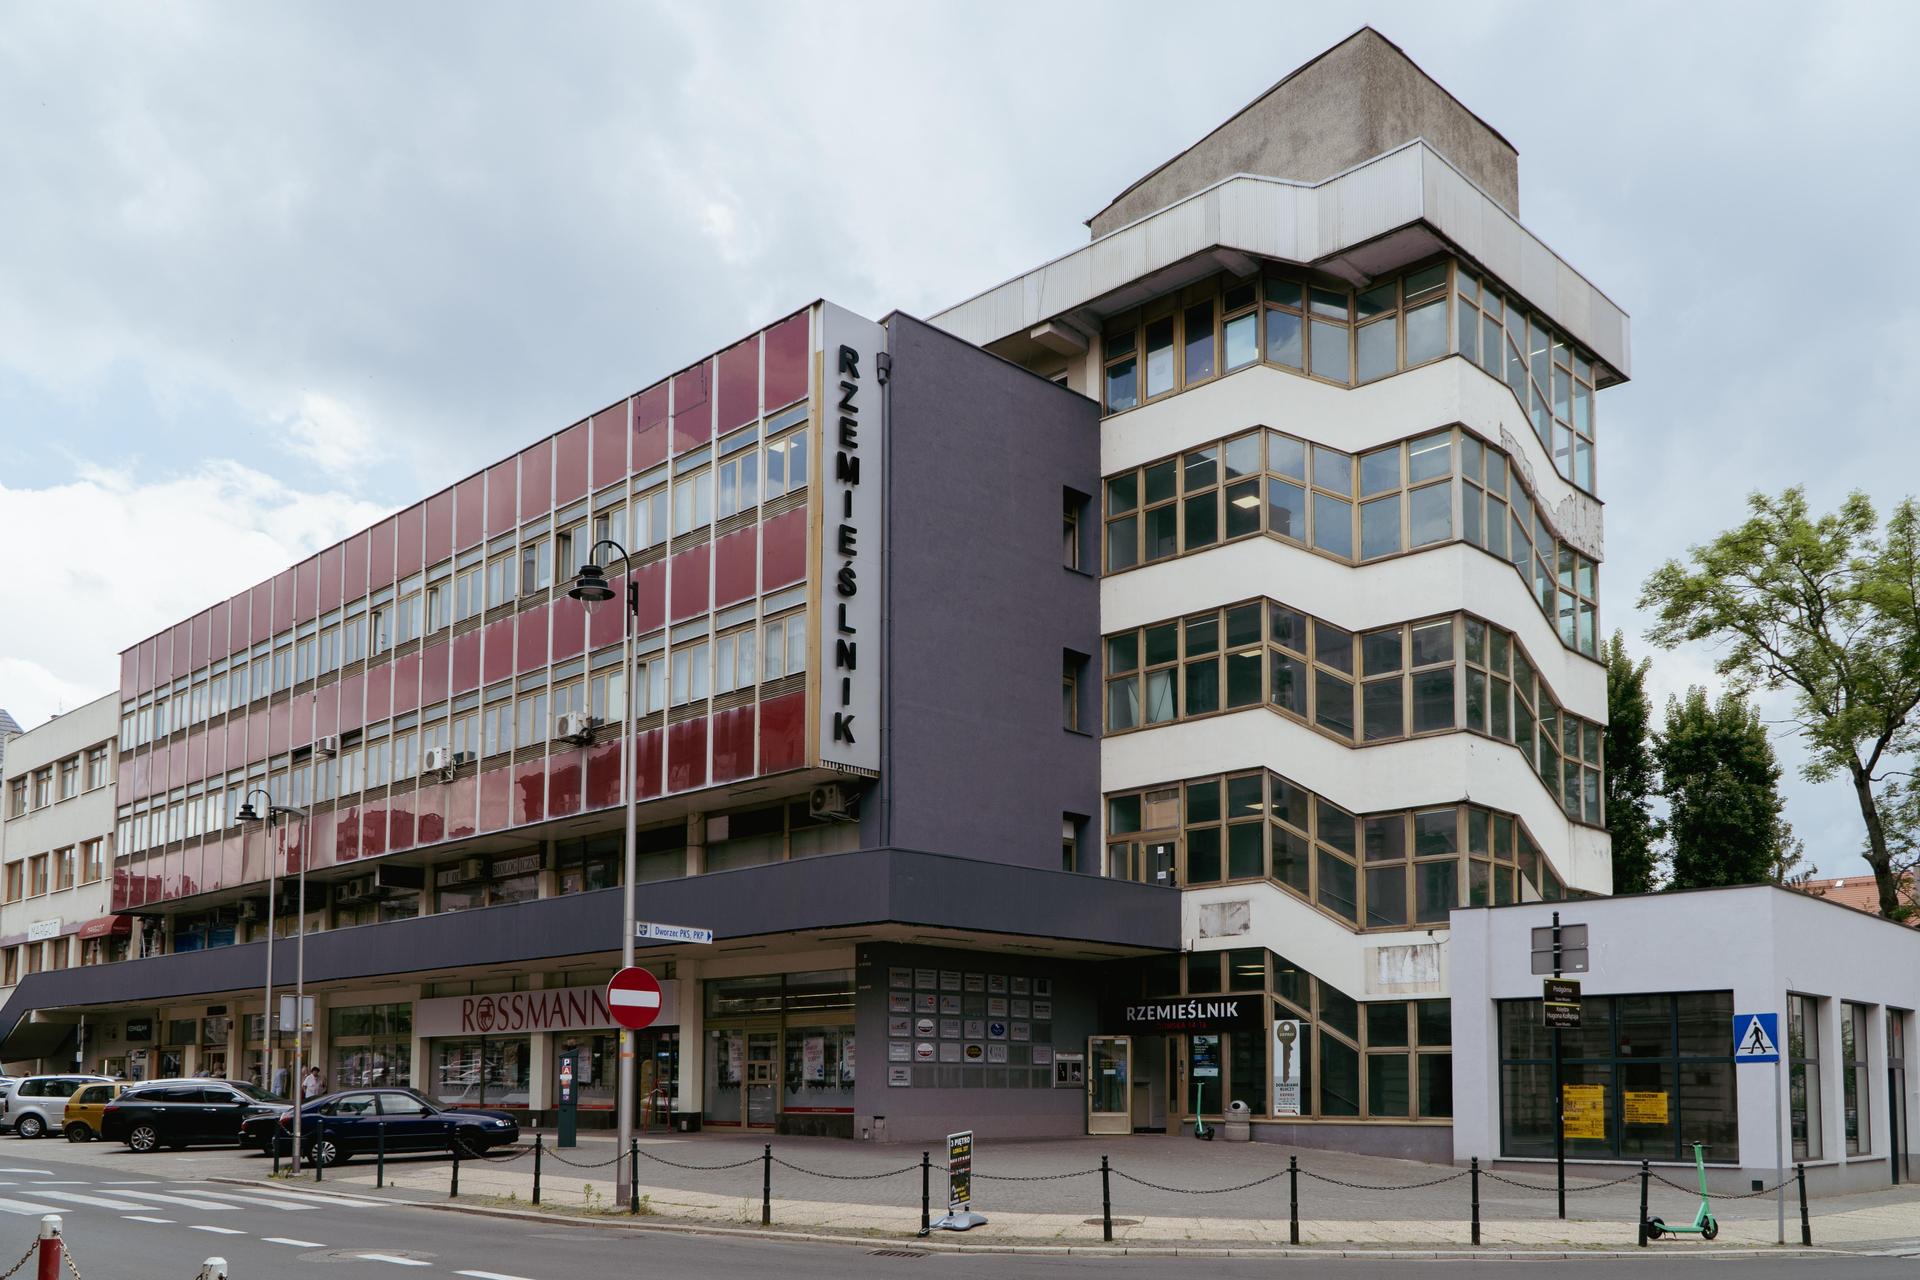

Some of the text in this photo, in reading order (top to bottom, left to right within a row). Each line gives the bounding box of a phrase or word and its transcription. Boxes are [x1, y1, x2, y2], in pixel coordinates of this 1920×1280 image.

[833, 344, 860, 744] RZEMIEŚLNIK
[655, 926, 680, 937] Dworzec
[1126, 1000, 1239, 1021] RZEMIEŚLNIK
[563, 1058, 570, 1066] P
